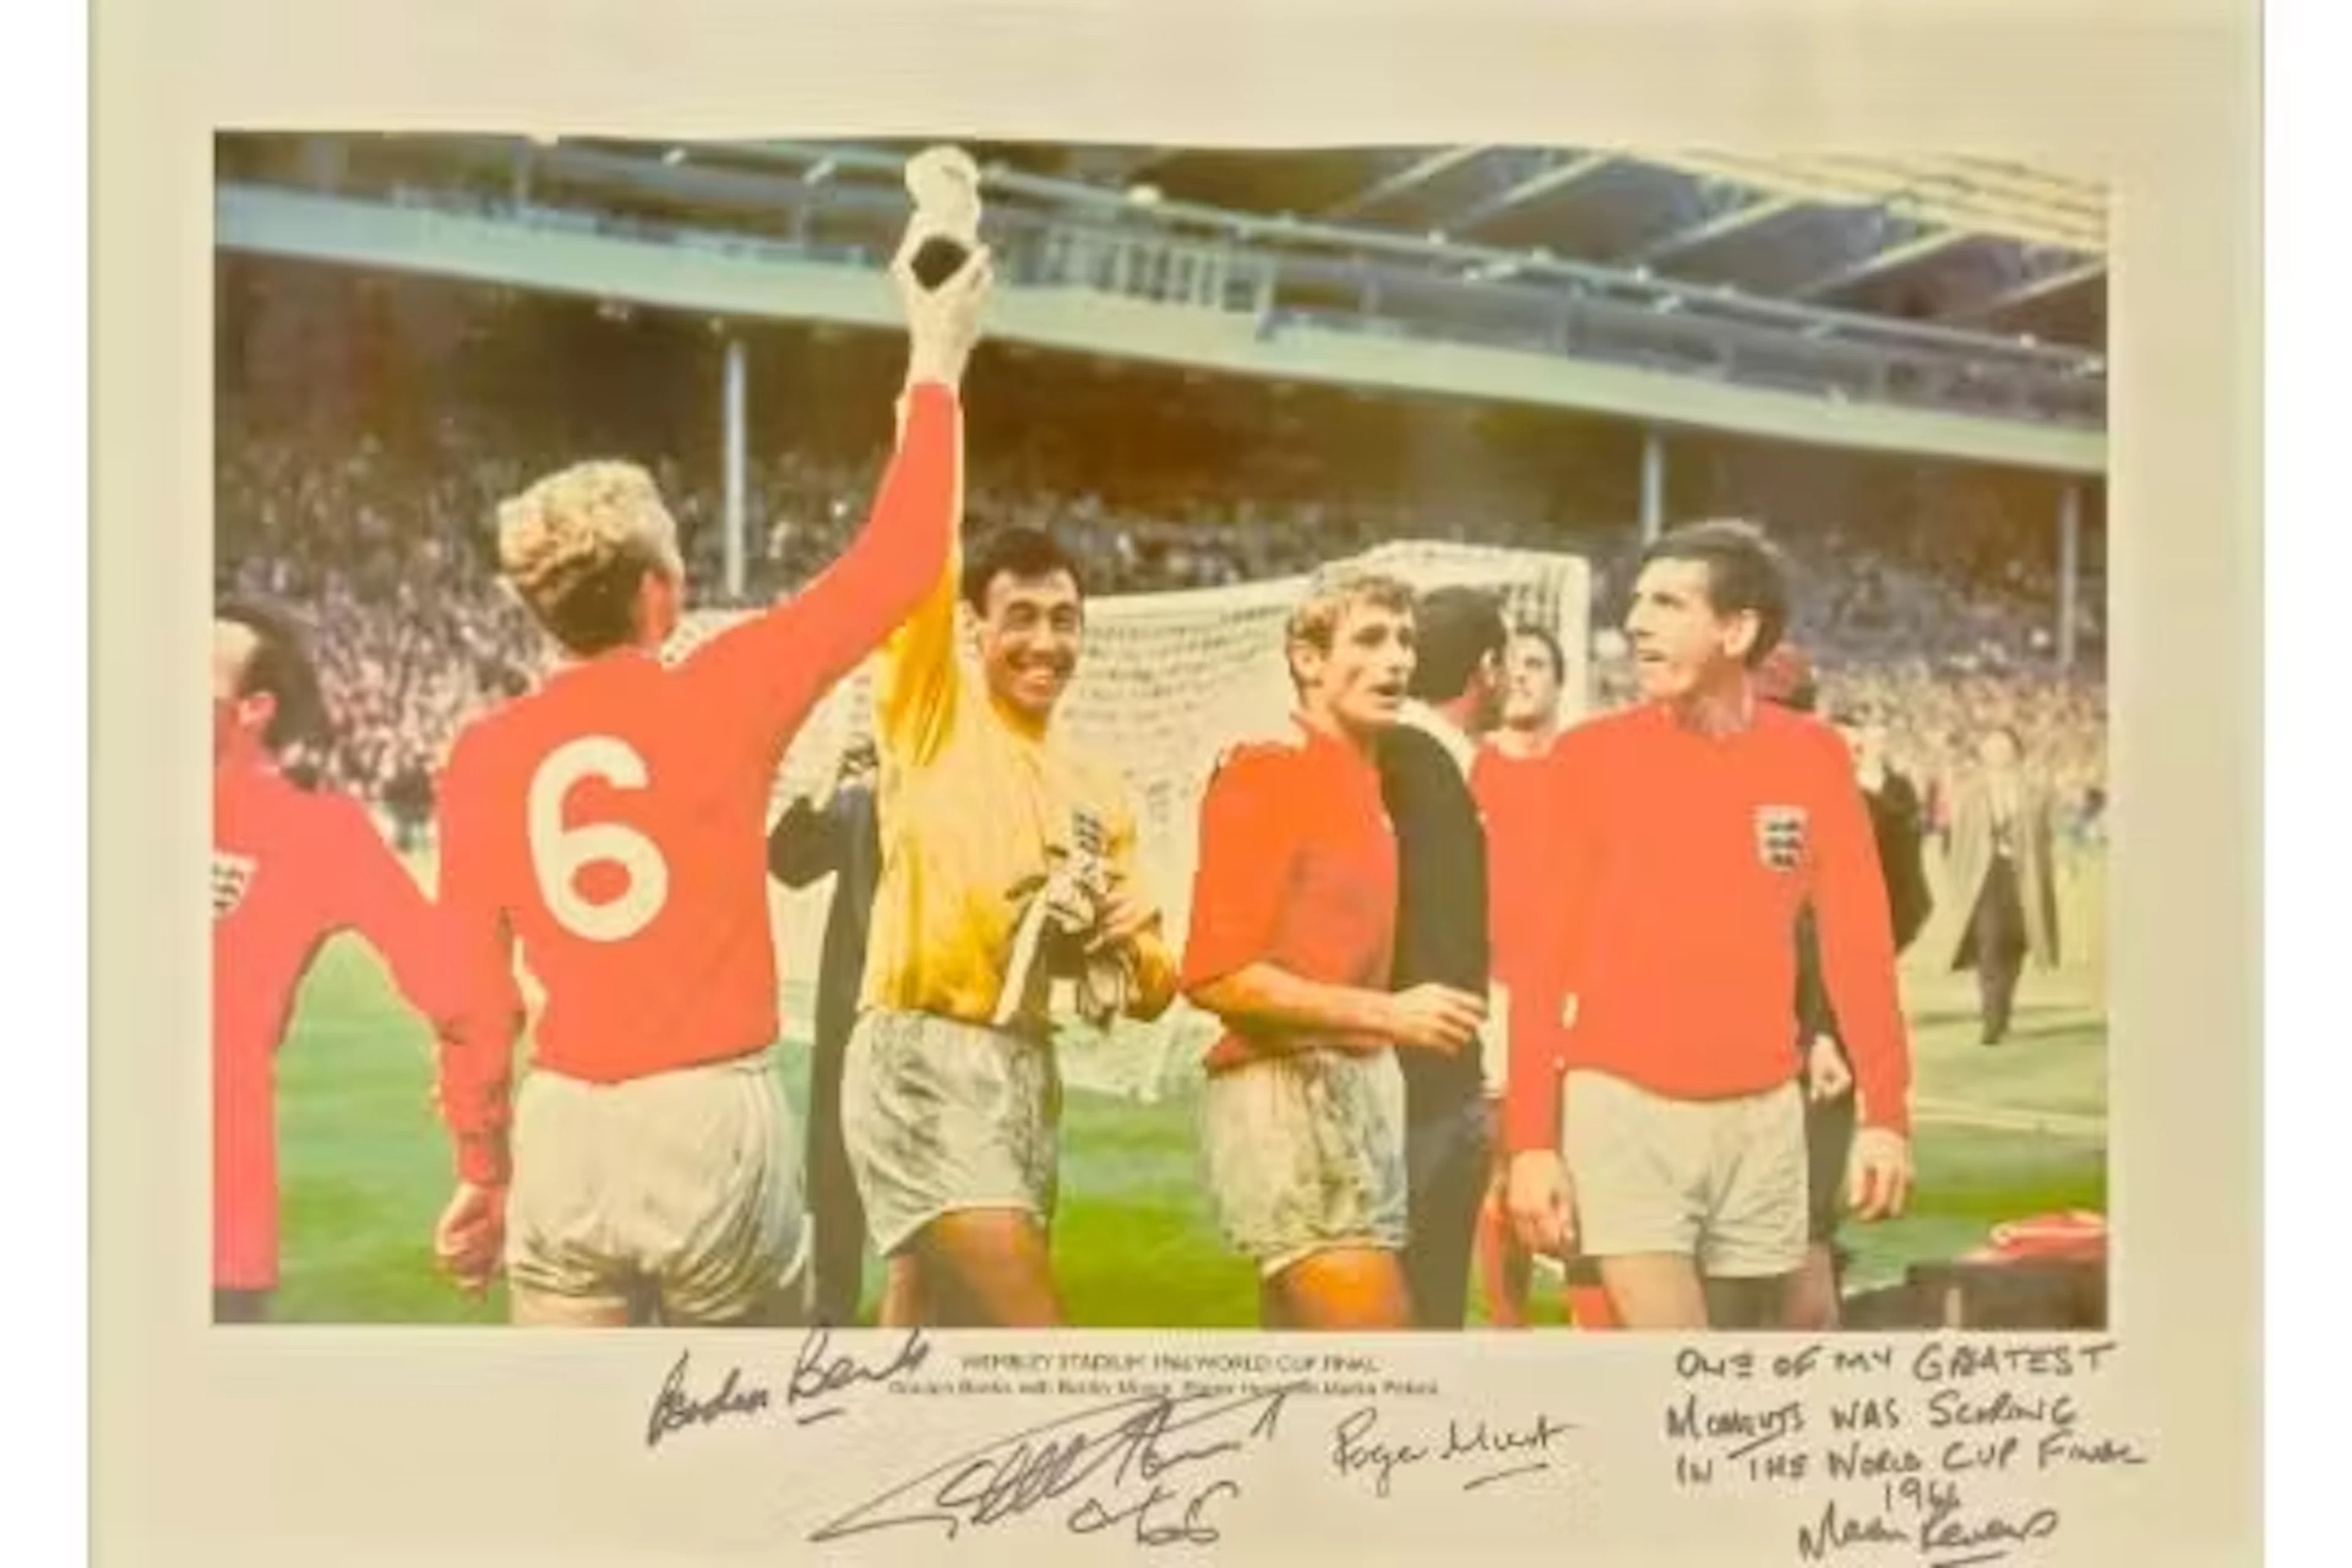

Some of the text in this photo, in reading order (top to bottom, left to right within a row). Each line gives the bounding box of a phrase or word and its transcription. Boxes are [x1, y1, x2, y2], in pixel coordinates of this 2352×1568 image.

[526, 733, 669, 943] 6
[1058, 1352, 1145, 1372] STADIUM
[1193, 1352, 1270, 1372] WORLD
[1276, 1352, 1316, 1372] CUP
[1322, 1352, 1383, 1372] FINAL
[1773, 1346, 1823, 1376] OF
[1833, 1348, 1893, 1371] MY
[1831, 1397, 1900, 1430] WAS
[1943, 1437, 2018, 1470] CUP
